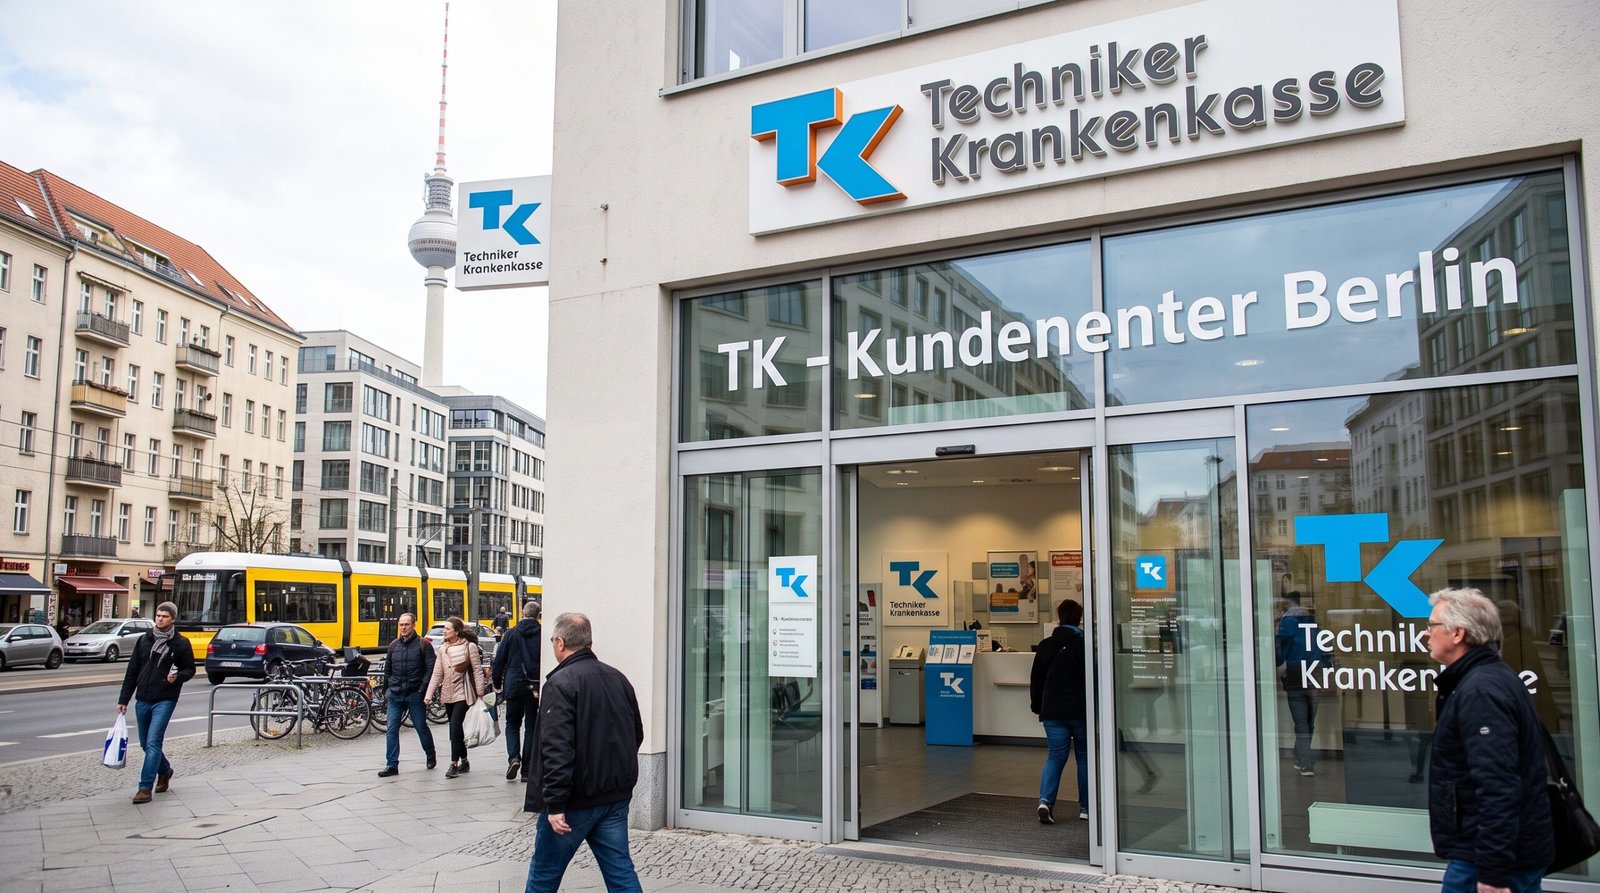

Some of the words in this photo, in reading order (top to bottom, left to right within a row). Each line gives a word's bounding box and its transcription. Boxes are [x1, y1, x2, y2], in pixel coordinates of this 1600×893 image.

[921, 34, 1207, 128] Techniker
[930, 62, 1386, 186] Krankenkasse
[751, 87, 907, 205] TK
[469, 189, 541, 245] TK
[463, 250, 519, 262] Techniker
[463, 261, 543, 275] Krankenkasse
[718, 336, 788, 391] TK
[847, 291, 1259, 379] Kundenenter
[1284, 247, 1519, 330] Berlin
[776, 567, 809, 597] TK
[889, 561, 939, 598] TK
[1140, 562, 1163, 580] TK
[1294, 512, 1446, 618] TK
[1298, 623, 1429, 652] Technik
[940, 672, 965, 693] TK
[1301, 660, 1539, 694] Krankene
